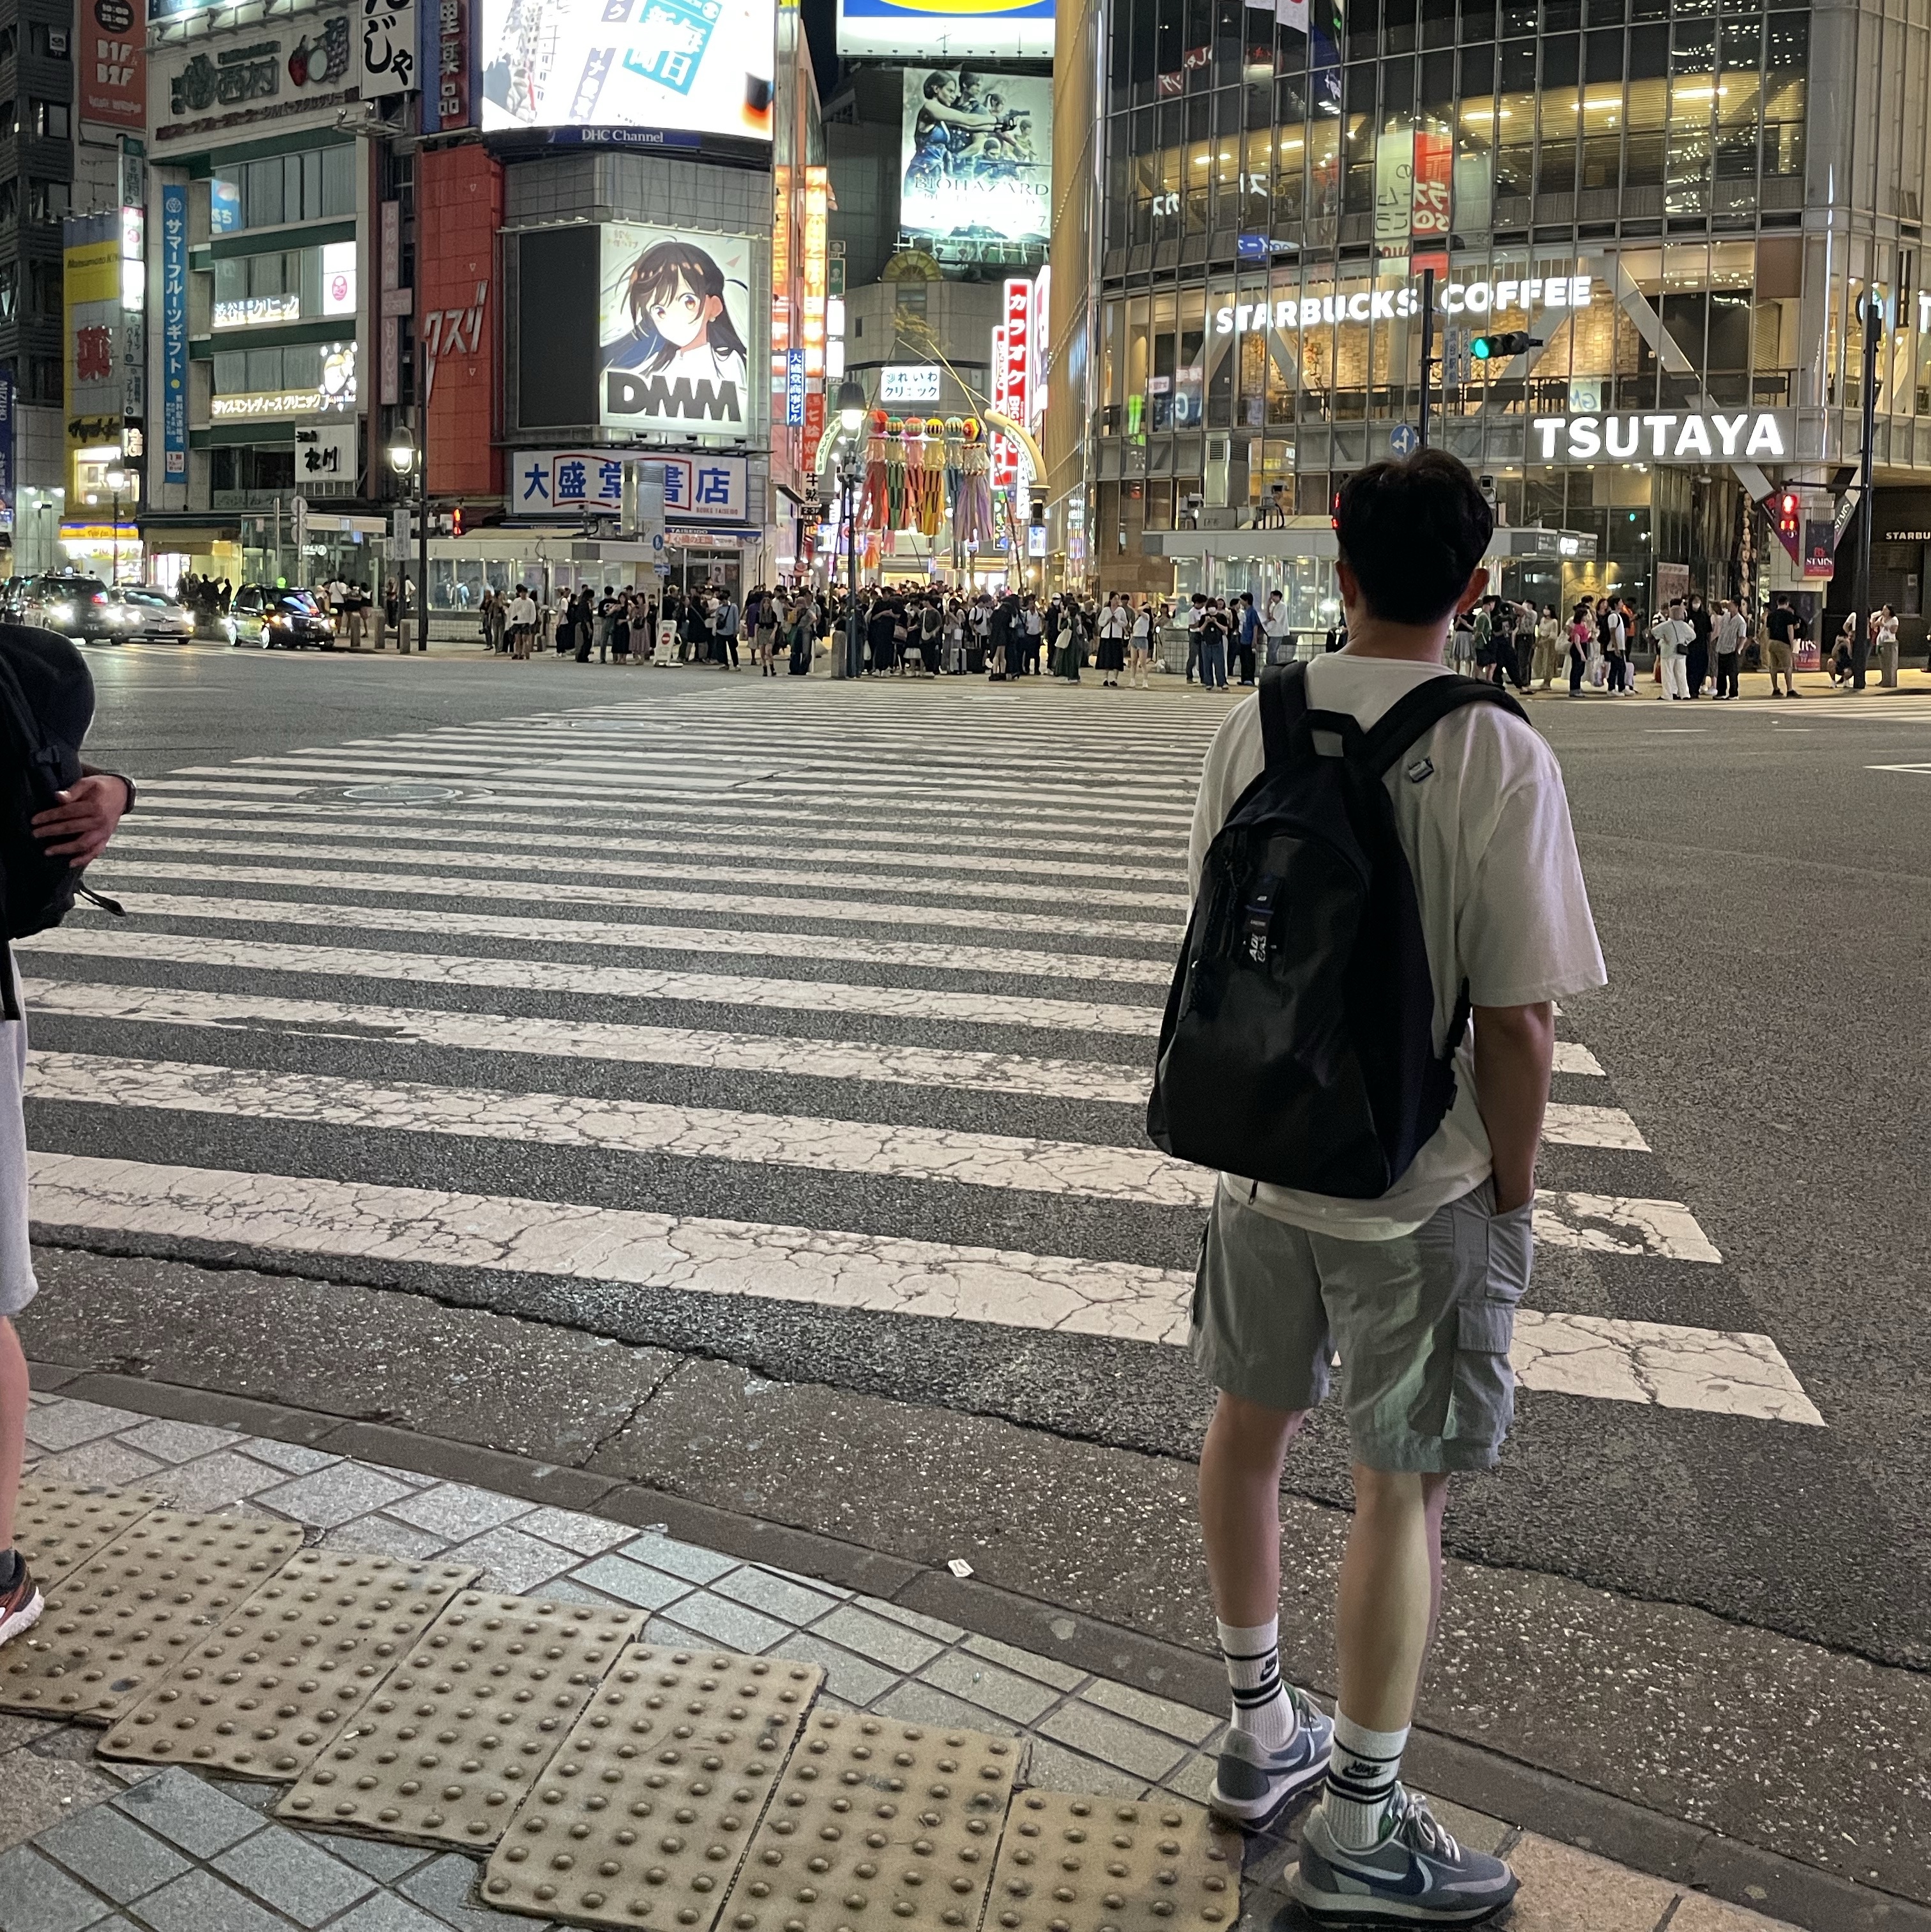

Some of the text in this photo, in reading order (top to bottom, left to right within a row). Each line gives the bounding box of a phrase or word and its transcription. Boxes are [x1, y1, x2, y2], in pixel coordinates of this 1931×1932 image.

[97, 39, 133, 62] B1F
[363, 0, 413, 86] じゃ
[96, 63, 135, 86] B2F
[582, 129, 664, 143] DHC Channel
[915, 176, 1049, 195] BIOHAZARD
[166, 218, 183, 374] サマーフルーツギフト
[1216, 275, 1591, 334] STARBUCKS COFFEE
[423, 279, 489, 406] クスリ
[1009, 295, 1027, 386] カラオケ
[607, 371, 741, 422] DMM
[790, 353, 802, 423] 大盛堂商事ビル
[885, 386, 937, 397] クリニック
[897, 372, 938, 383] れいわ
[1533, 413, 1785, 458] TSUTAYA
